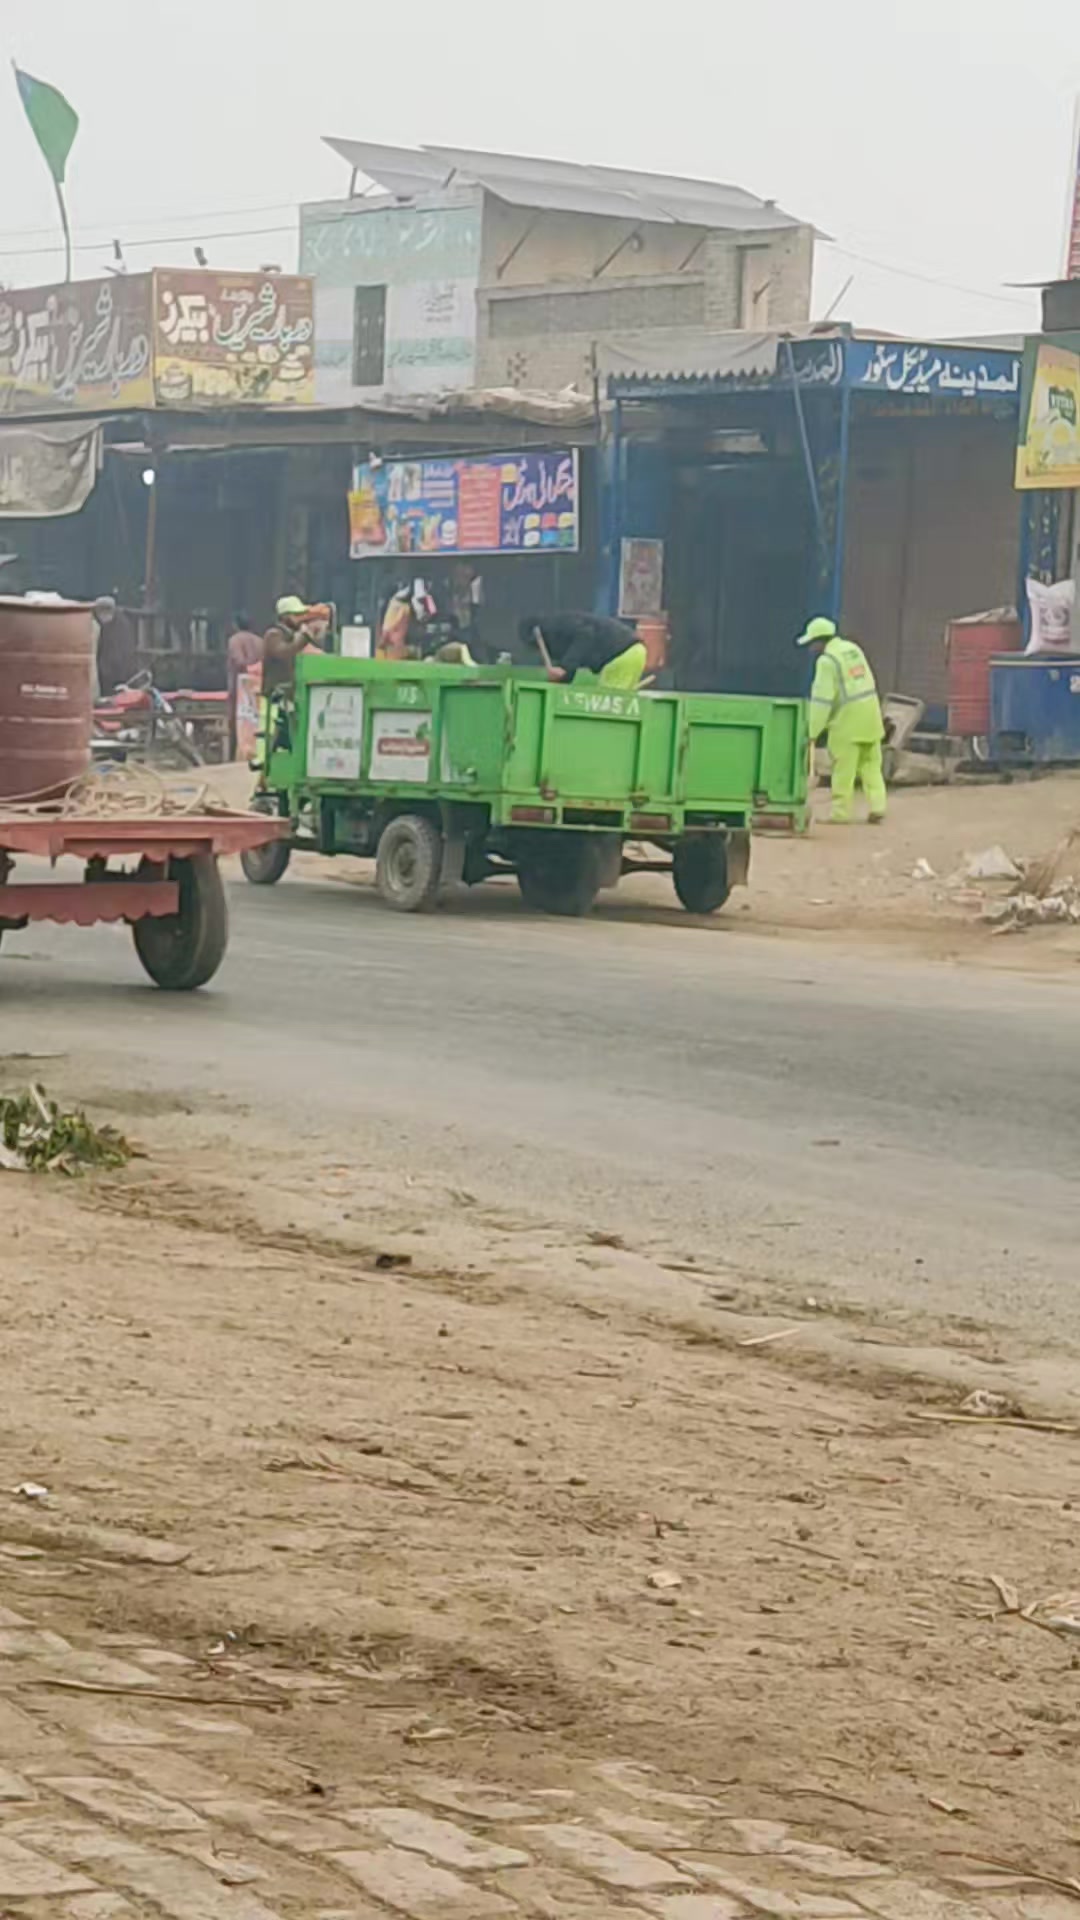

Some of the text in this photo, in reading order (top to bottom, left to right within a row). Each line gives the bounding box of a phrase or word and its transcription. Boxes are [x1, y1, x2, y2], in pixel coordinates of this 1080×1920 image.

[160, 291, 210, 344] بیکرز
[886, 346, 942, 393] میڈیکل
[938, 359, 1020, 396] لمدینہ
